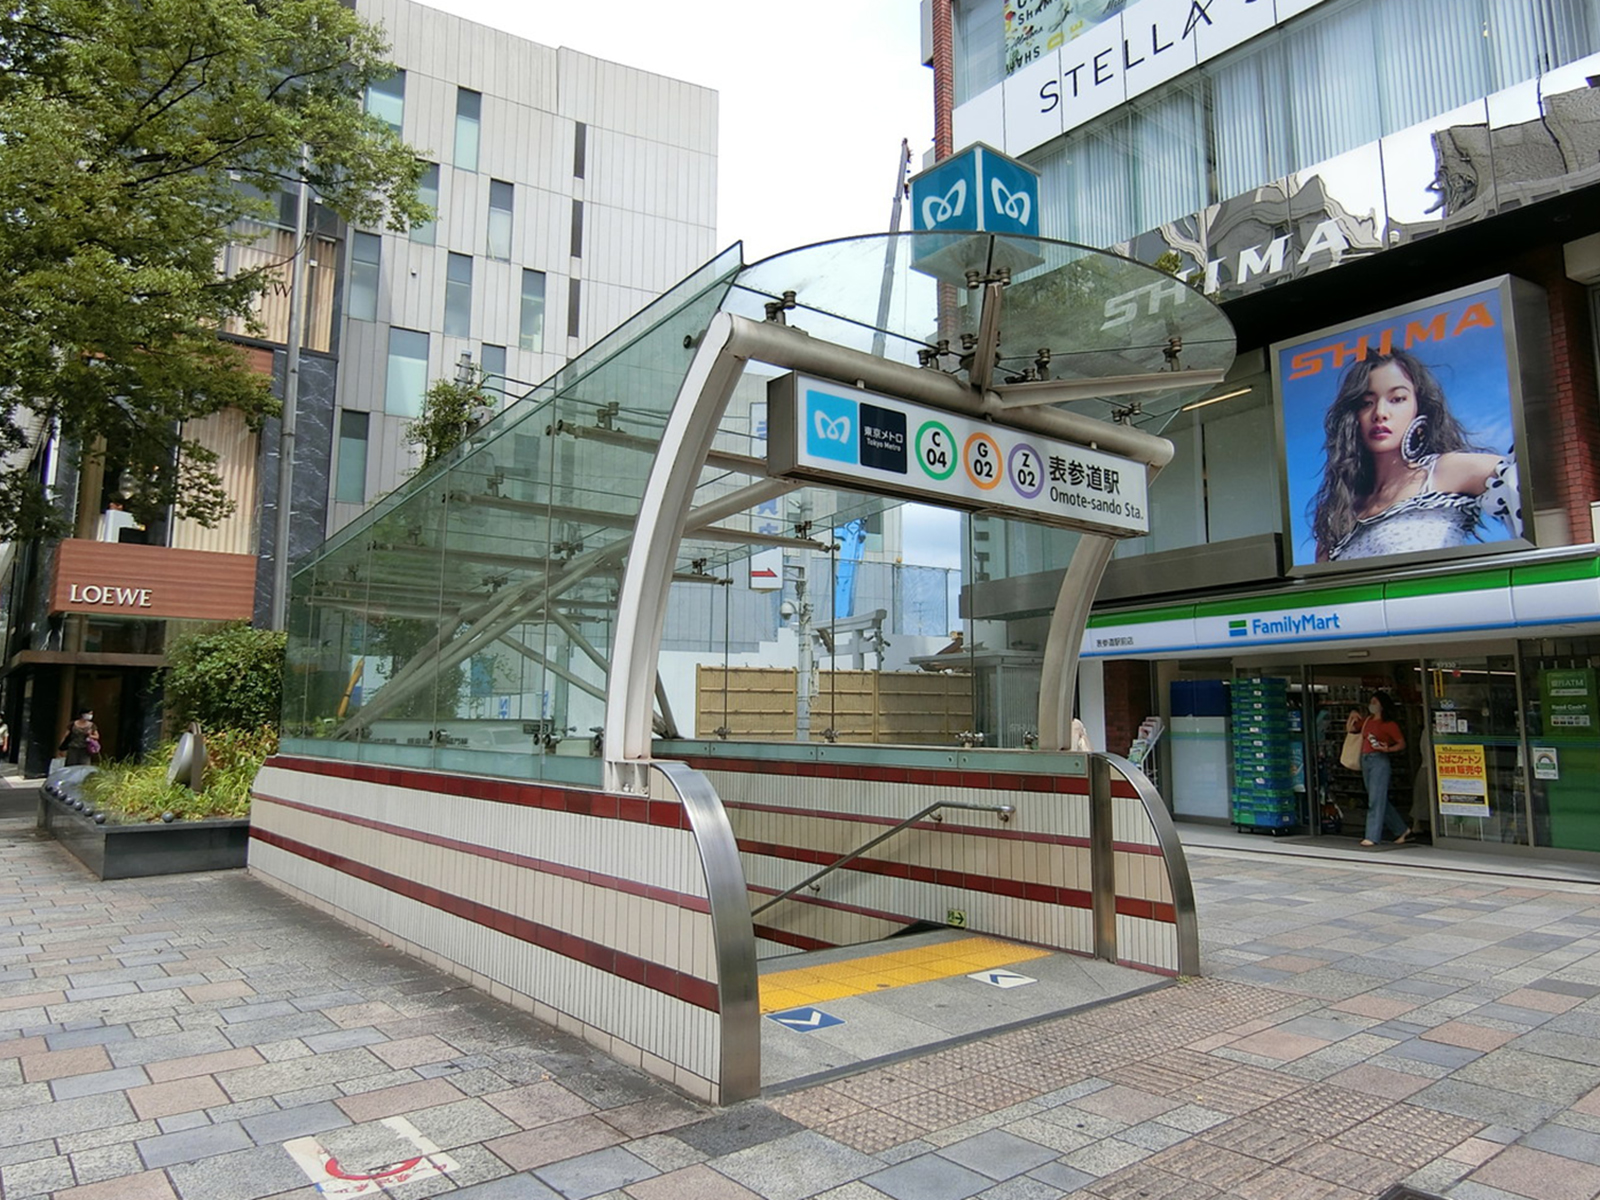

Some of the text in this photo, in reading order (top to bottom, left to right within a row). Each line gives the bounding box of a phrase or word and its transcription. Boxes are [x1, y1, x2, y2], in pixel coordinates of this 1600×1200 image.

[1038, 0, 1214, 113] STELLA
[1100, 215, 1350, 332] SHIMA
[1288, 301, 1497, 381] SHIMA
[863, 425, 904, 444] 東京メトロ
[866, 437, 902, 452] Tokyo Metro
[931, 431, 941, 448] C
[926, 448, 947, 468] 04
[977, 442, 989, 458] G
[1021, 452, 1031, 468] Z
[973, 459, 993, 478] 02
[1017, 469, 1036, 487] 02
[1048, 455, 1121, 496] 表参道駅
[1049, 486, 1144, 520] Omote-sando Sta.
[69, 584, 153, 607] LOEWE
[1252, 612, 1341, 636] FamilyMart
